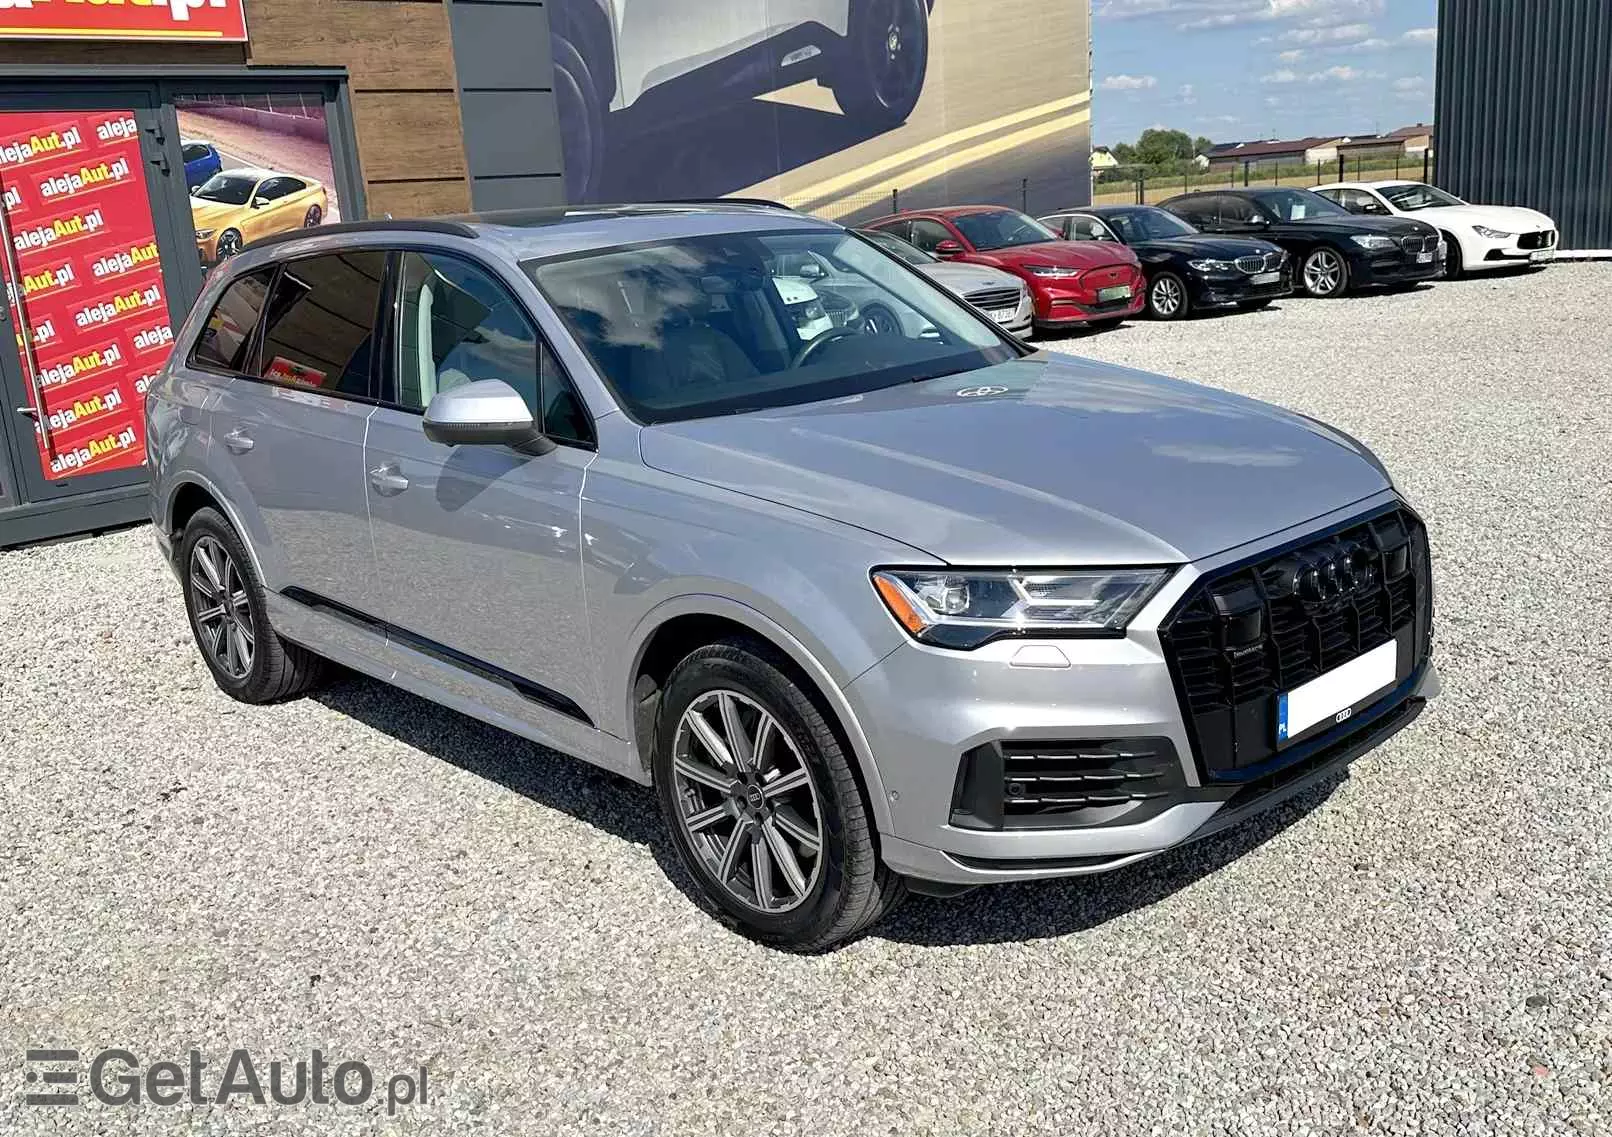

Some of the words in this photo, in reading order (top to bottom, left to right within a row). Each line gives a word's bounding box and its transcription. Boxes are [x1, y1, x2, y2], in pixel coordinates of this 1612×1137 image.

[0, 127, 81, 164] lejaAut.pl
[40, 158, 129, 197] alejaAut.pl
[14, 209, 104, 250] alejaAut.pl
[75, 285, 161, 326] alejaAut.pl
[50, 427, 136, 472] alejaAut.pl
